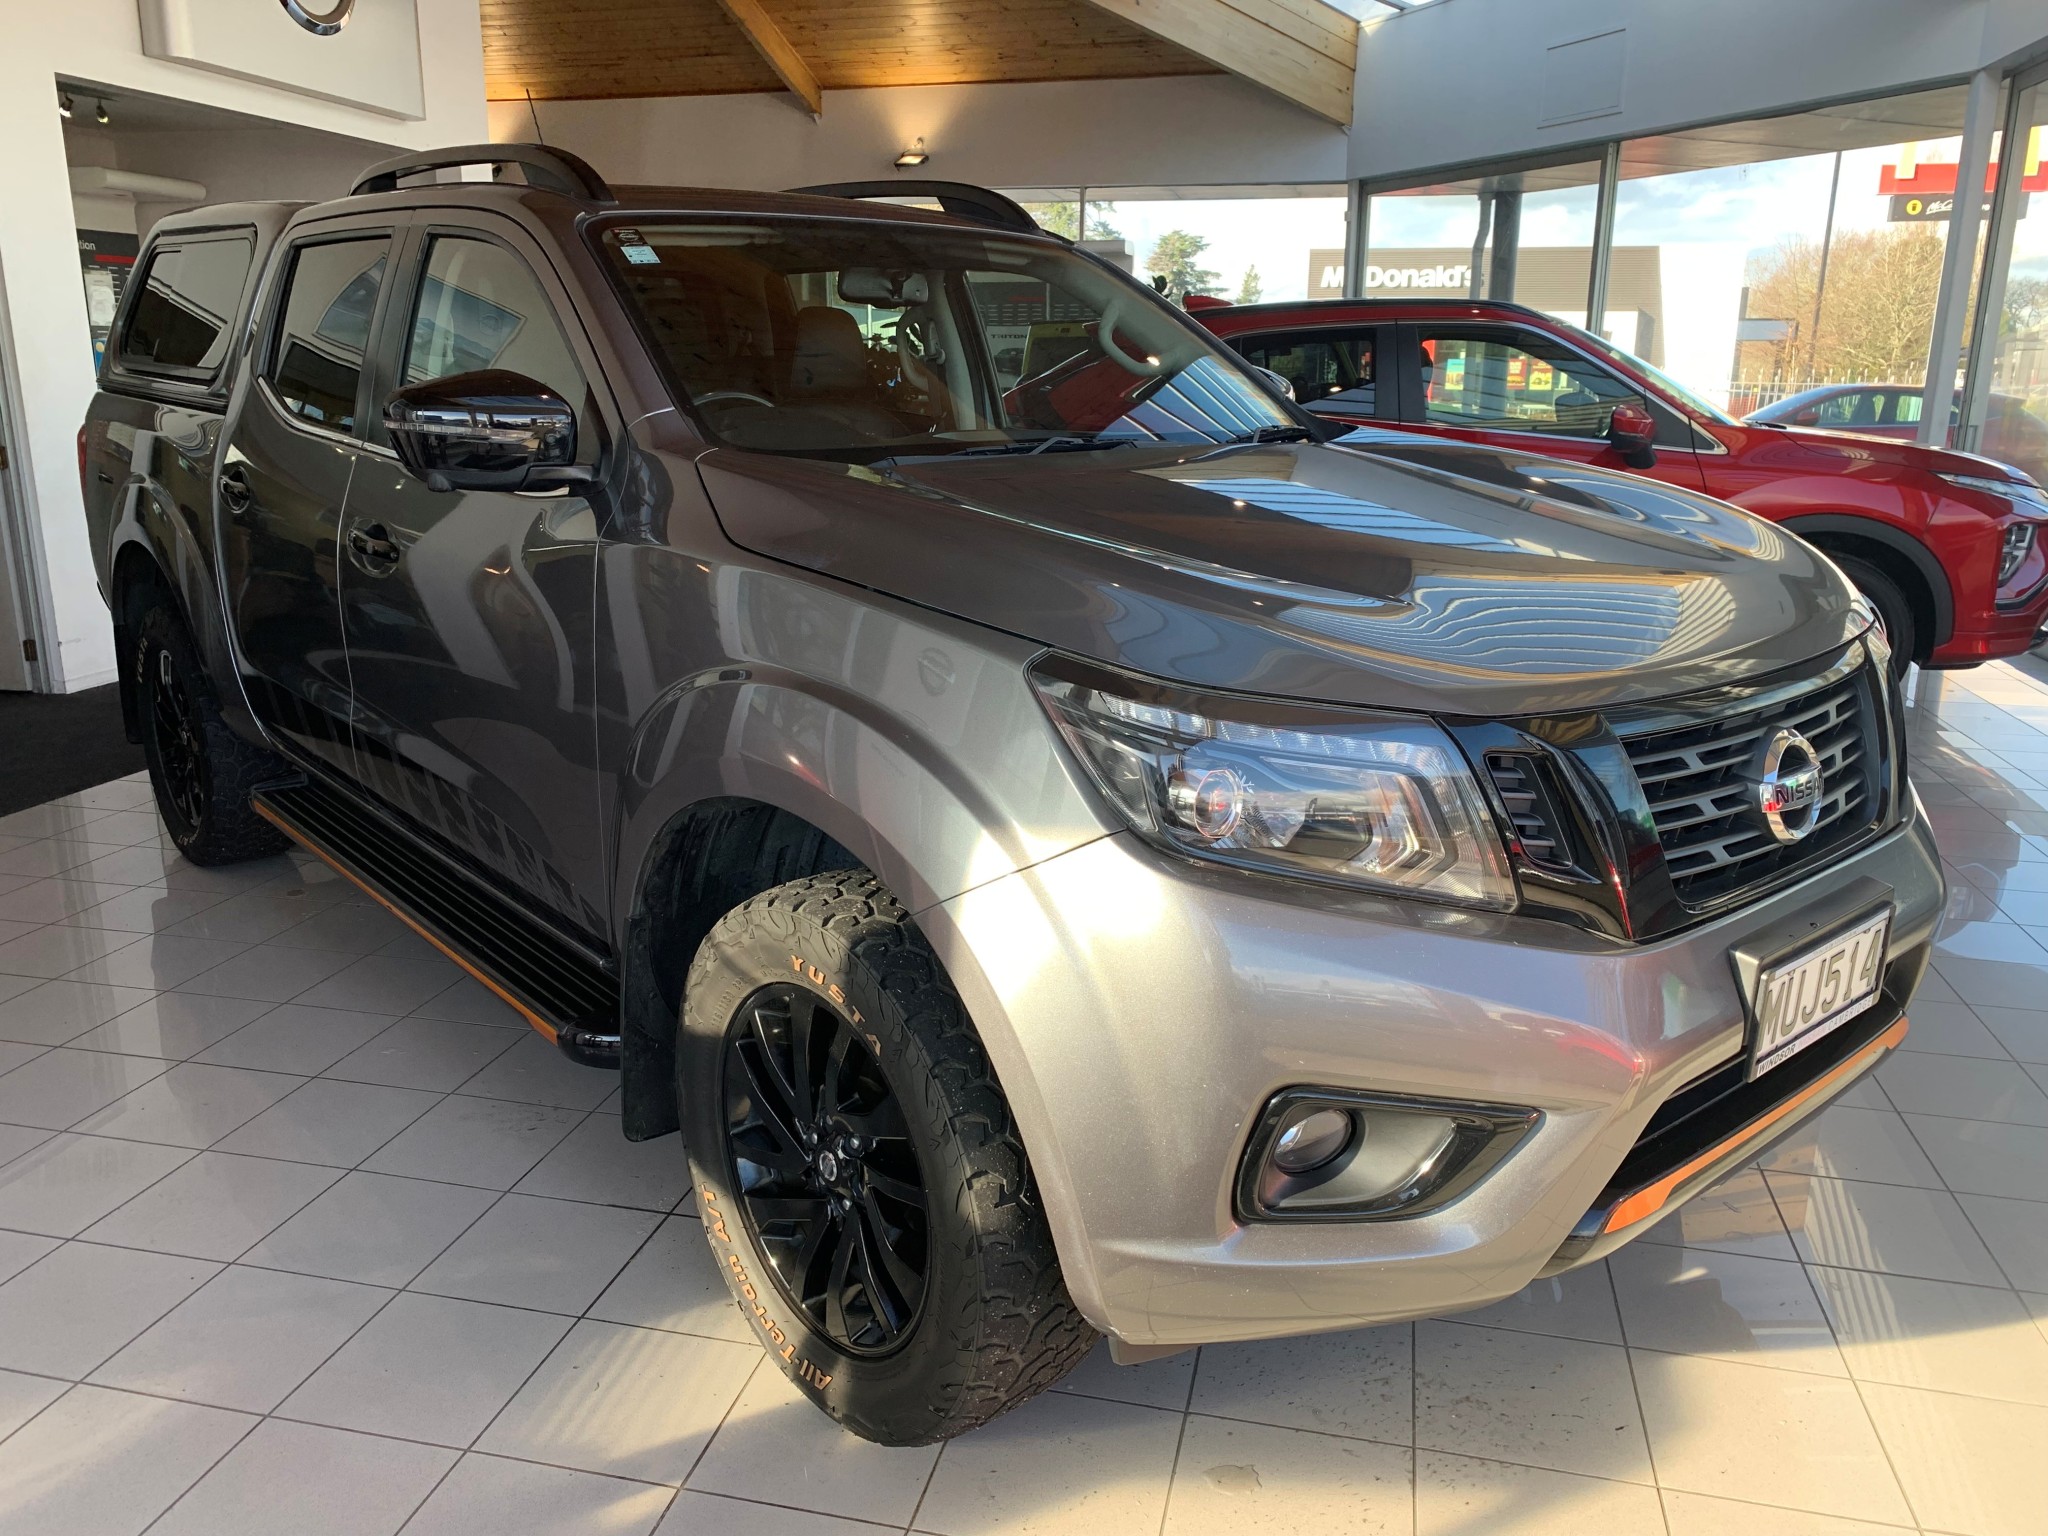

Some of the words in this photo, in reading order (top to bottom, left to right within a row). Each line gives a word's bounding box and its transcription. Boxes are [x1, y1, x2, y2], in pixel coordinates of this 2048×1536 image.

[77, 239, 97, 250] tion
[1320, 265, 1484, 288] MDonald'
[791, 954, 882, 1057] YUSTA
[1757, 929, 1881, 1053] MUJ514
[1758, 1044, 1796, 1073] WINDSOR
[1827, 998, 1872, 1031] CAMBRIDGE
[701, 1184, 732, 1244] A/T
[728, 1254, 833, 1392] All-Terrain
